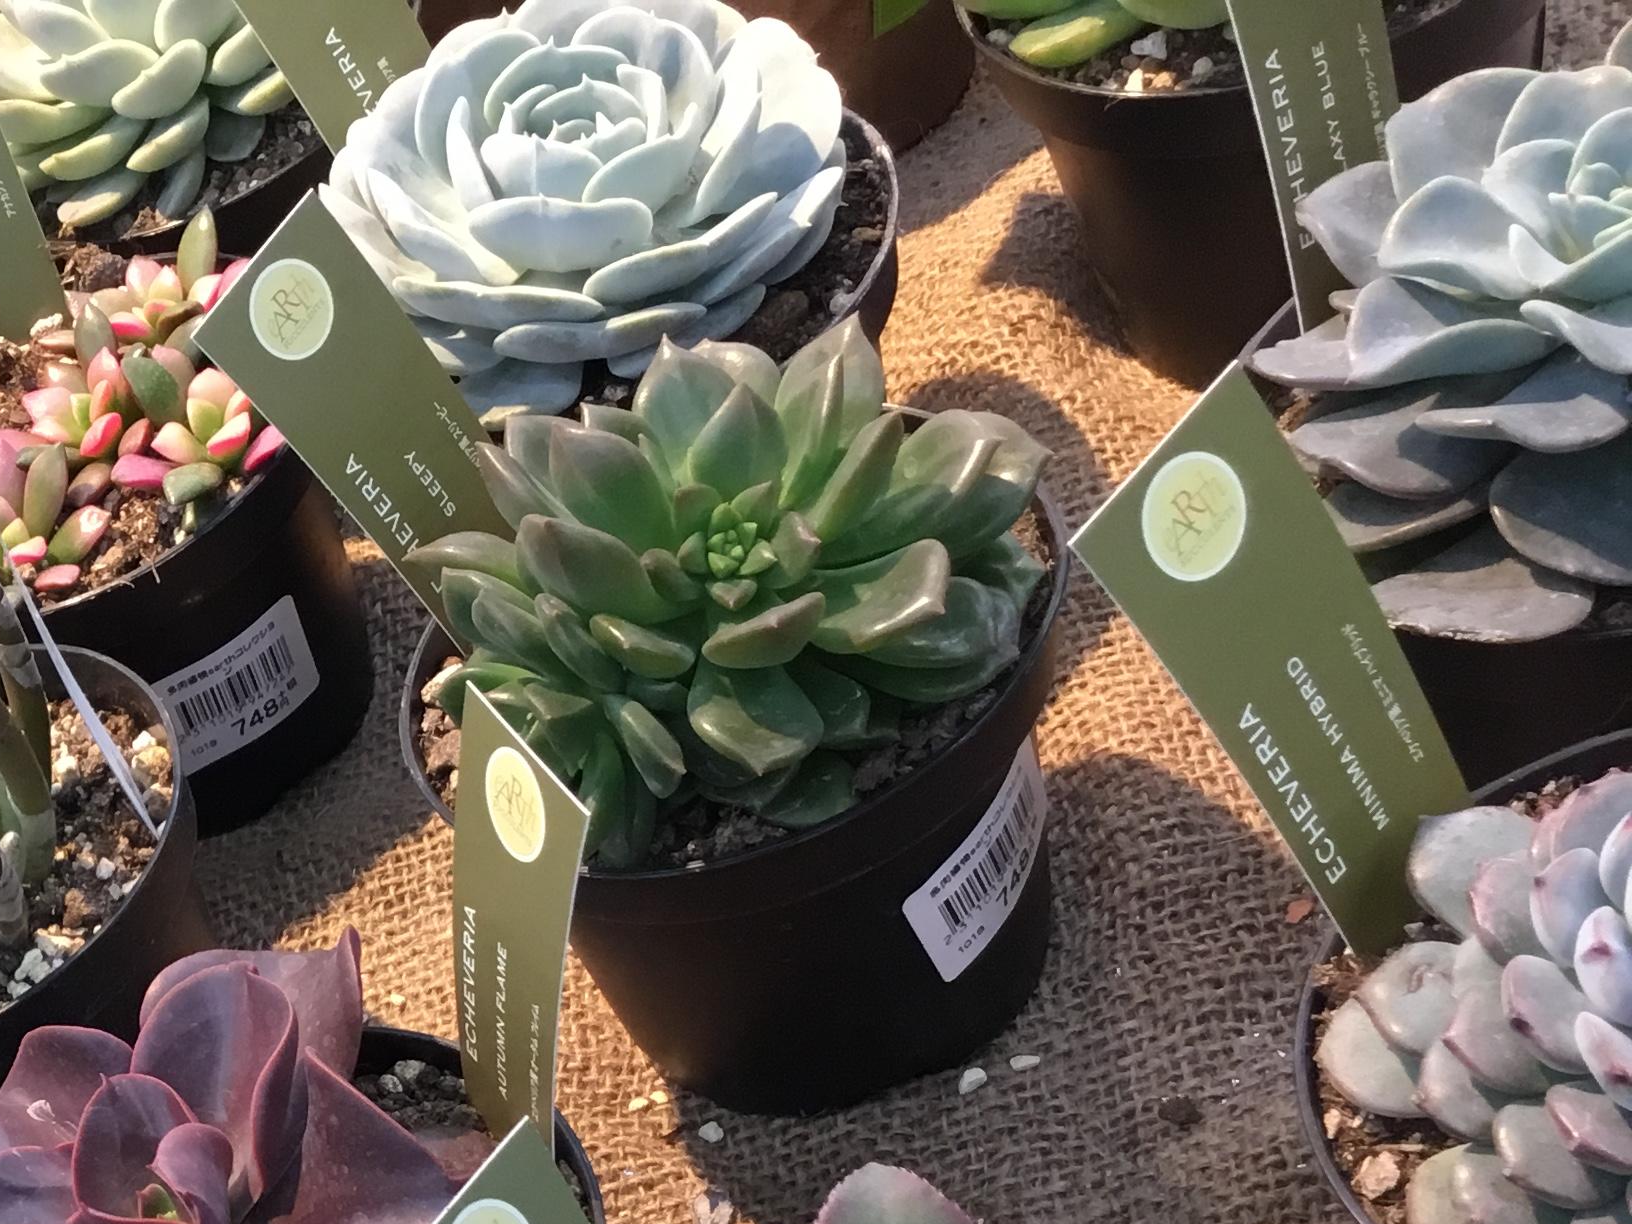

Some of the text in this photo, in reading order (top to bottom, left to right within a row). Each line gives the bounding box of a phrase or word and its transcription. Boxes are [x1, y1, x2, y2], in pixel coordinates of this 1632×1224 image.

[1265, 48, 1315, 250] EHEVERIA
[1312, 41, 1337, 110] BLUE
[404, 451, 456, 517] SLEEPY
[230, 698, 280, 736] 748
[1236, 702, 1347, 885] ECHEVERIA
[1286, 655, 1390, 831] MINIMA HYBRID
[463, 906, 478, 1063] ECHEVERIA
[495, 942, 508, 1101] AUTUMN FLAME
